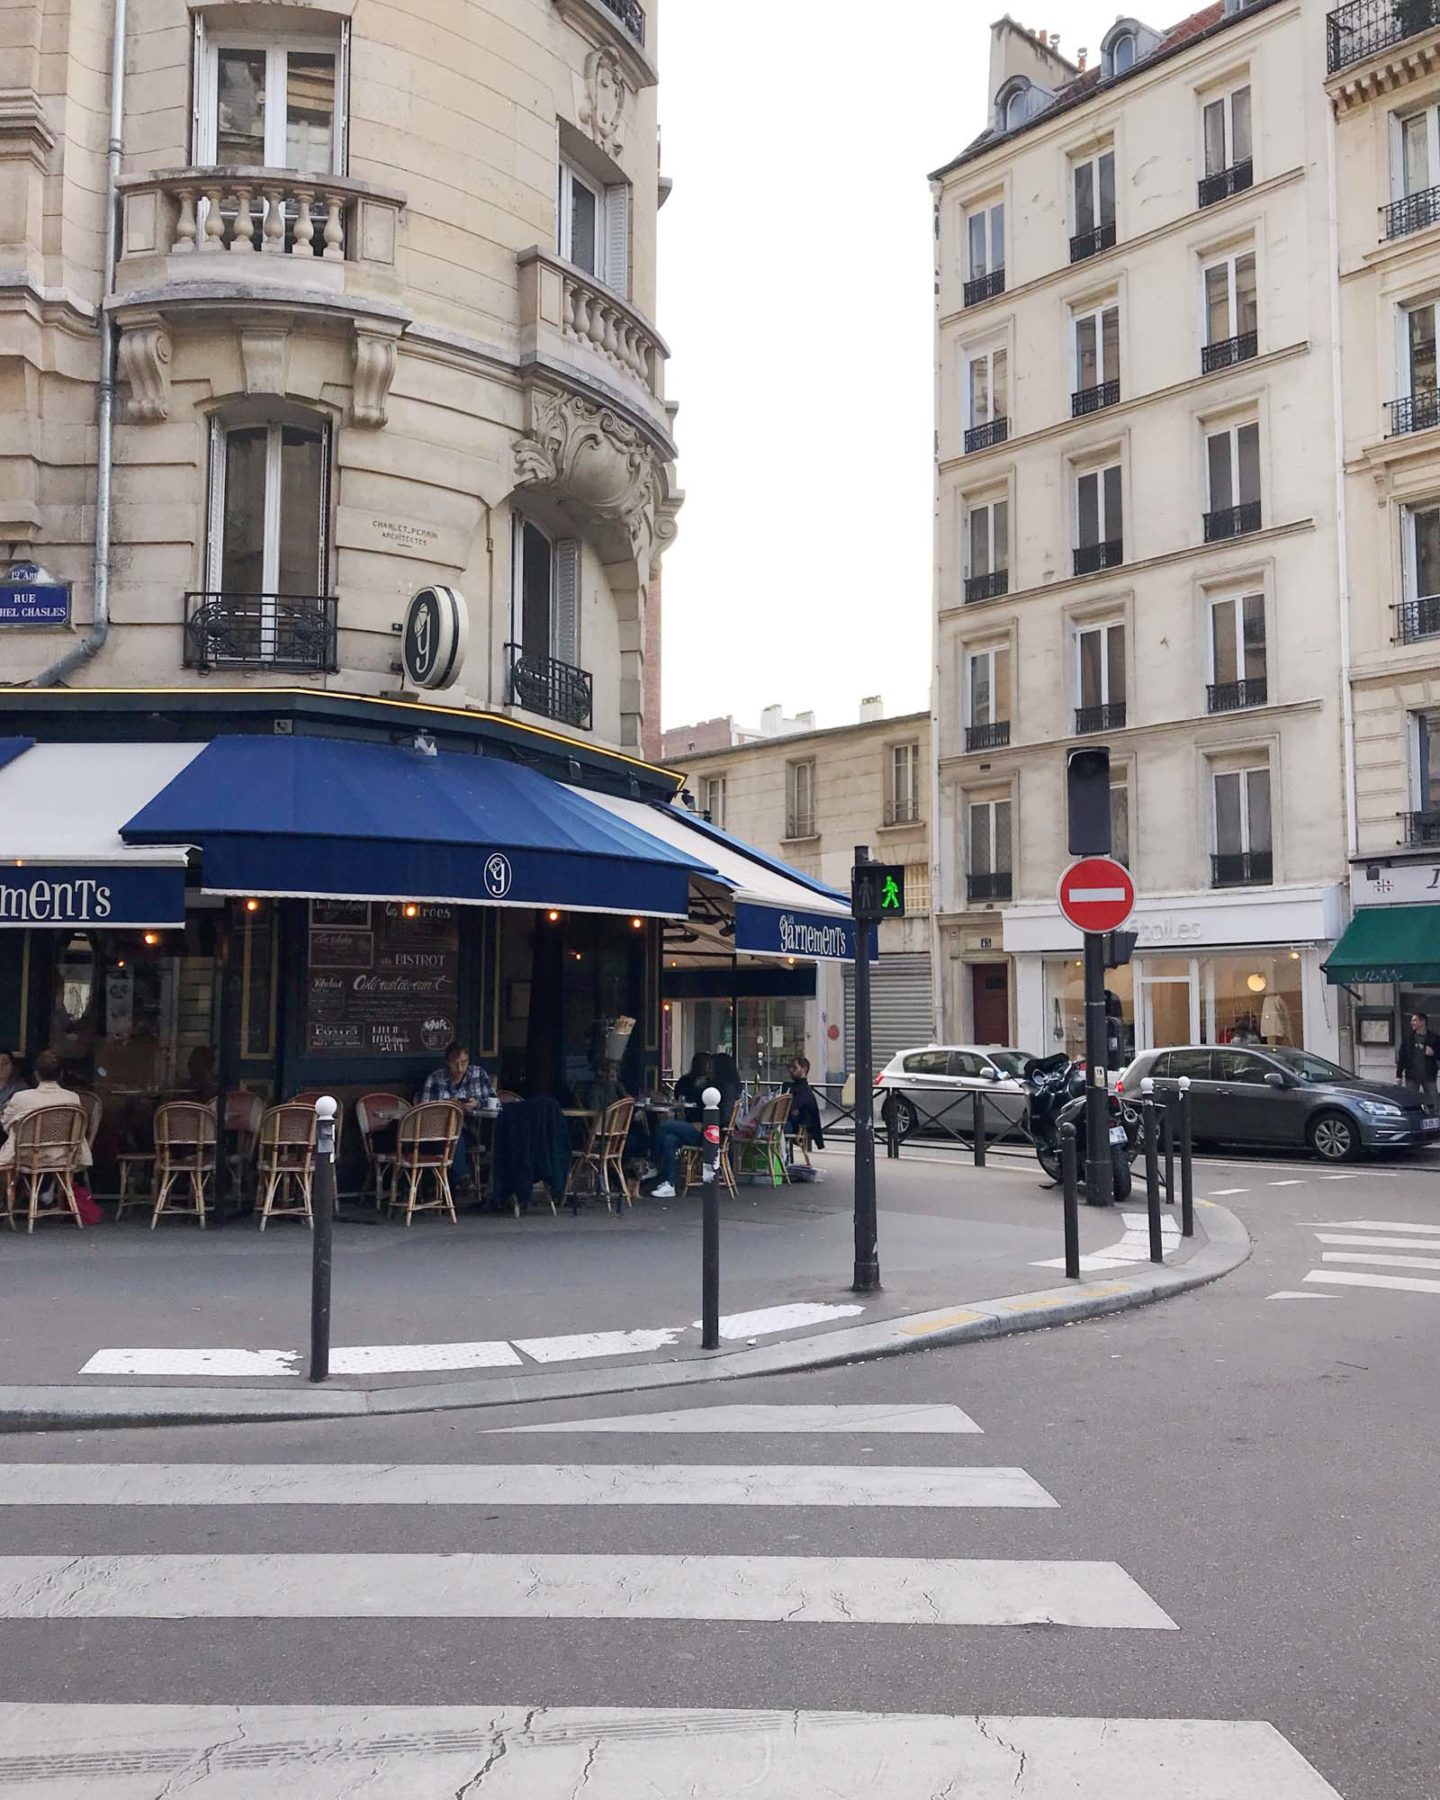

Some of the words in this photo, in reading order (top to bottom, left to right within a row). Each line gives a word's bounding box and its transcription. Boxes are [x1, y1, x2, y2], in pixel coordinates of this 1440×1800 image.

[13, 593, 36, 604] RUE
[21, 607, 66, 617] CHASLES
[396, 953, 447, 967] BISTROT
